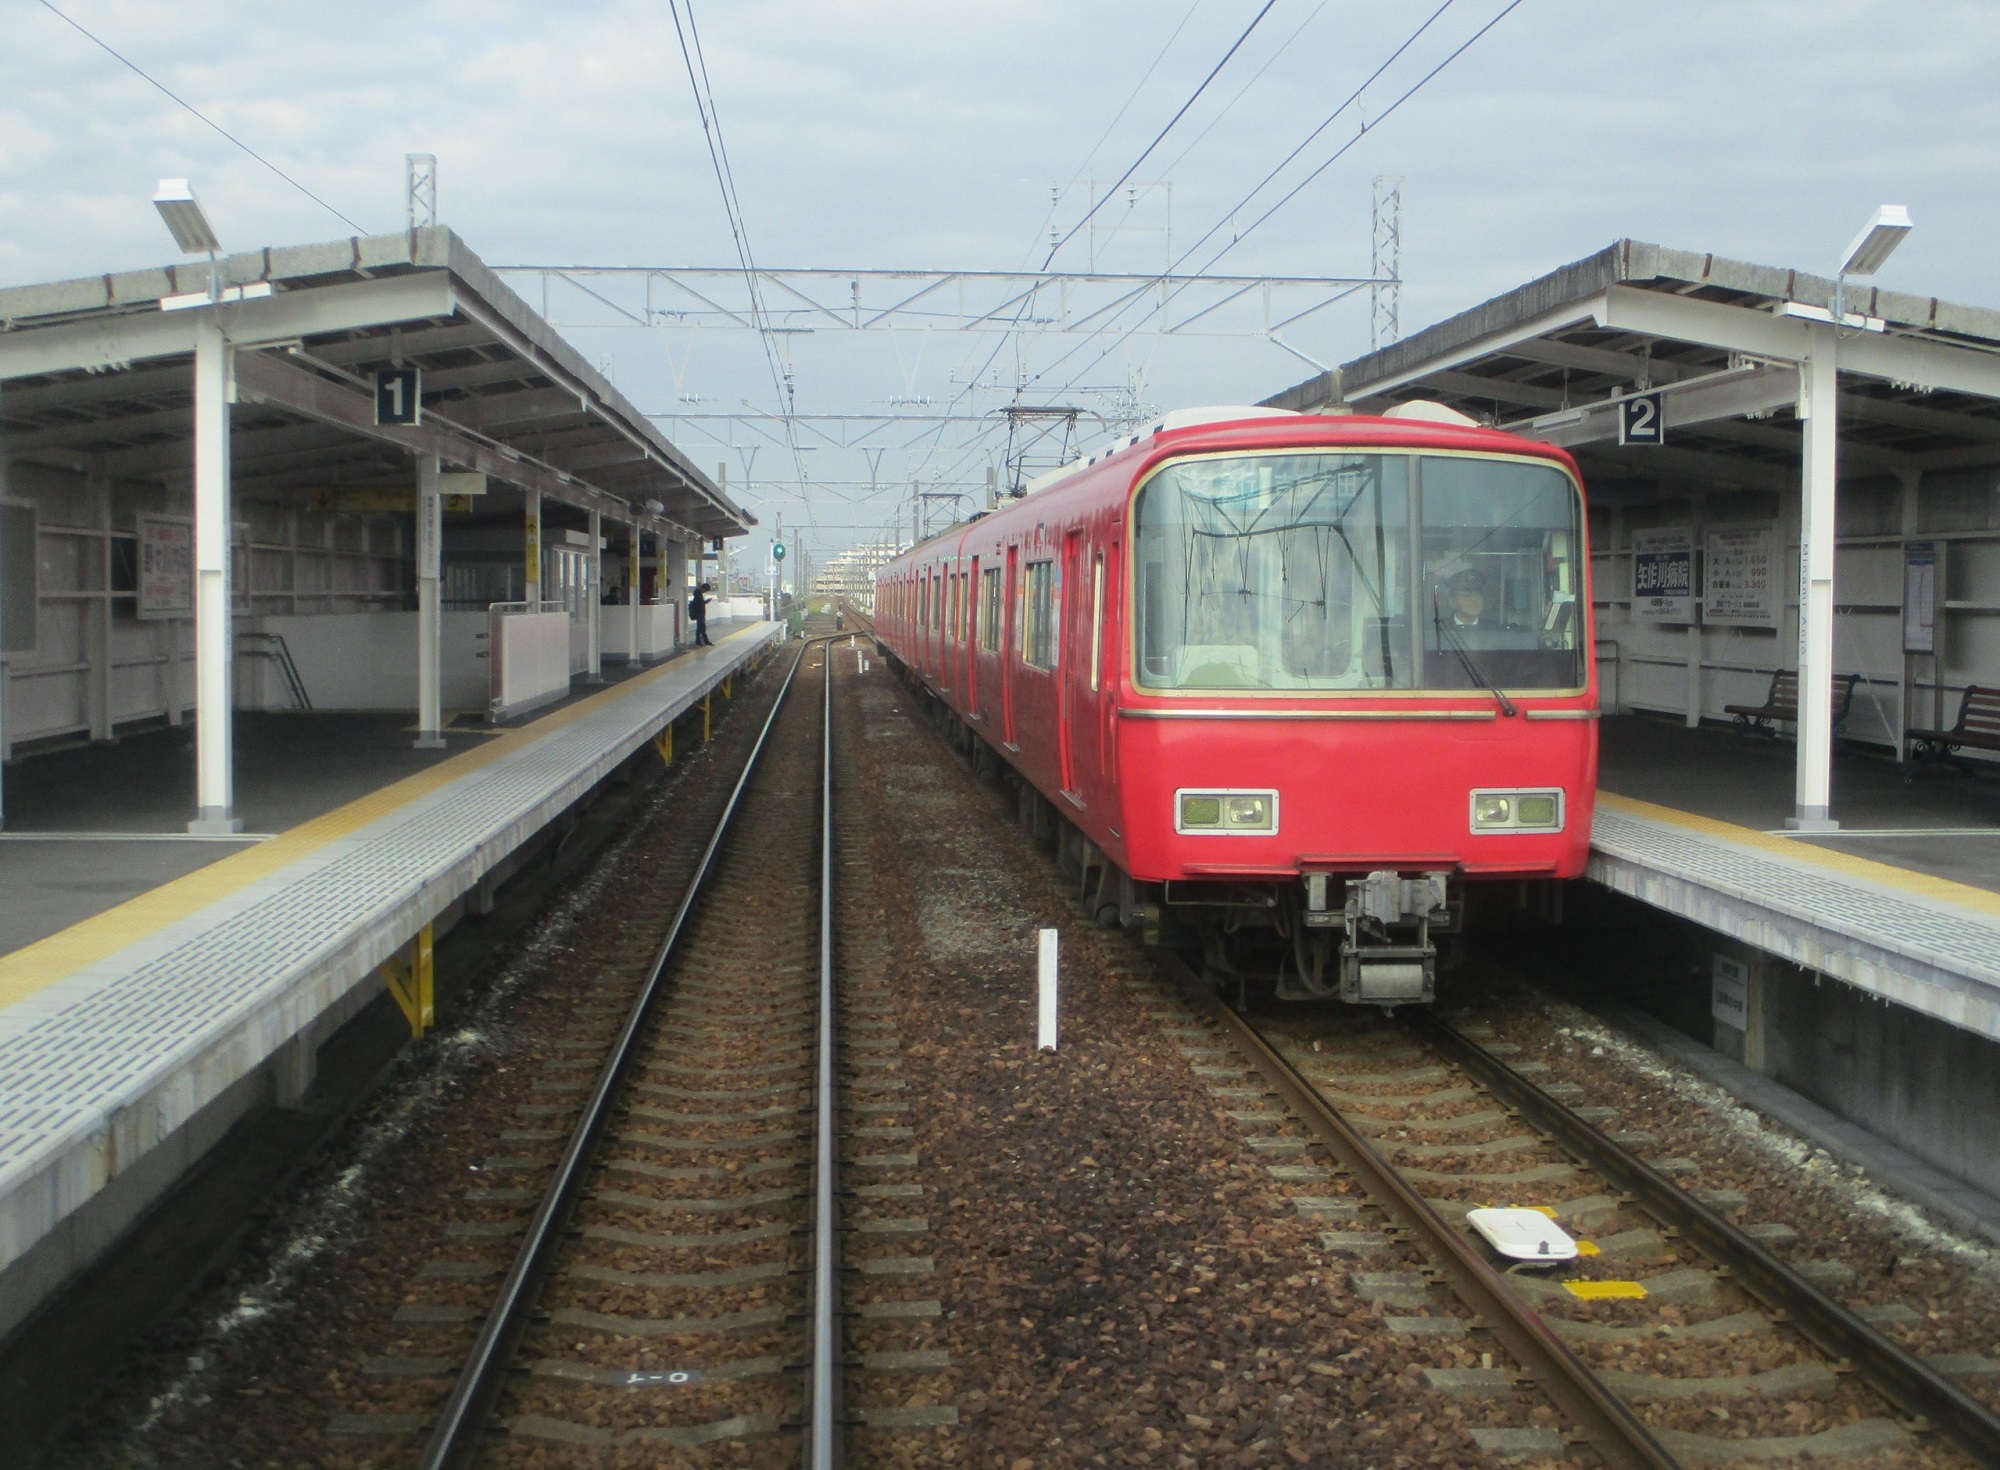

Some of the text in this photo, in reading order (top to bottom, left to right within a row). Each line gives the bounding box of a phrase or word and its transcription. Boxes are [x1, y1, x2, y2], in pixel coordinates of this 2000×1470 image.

[385, 377, 403, 416] 1
[1630, 398, 1655, 435] 2
[1637, 560, 1689, 589] 矢作川病院
[1751, 567, 1766, 577] 990
